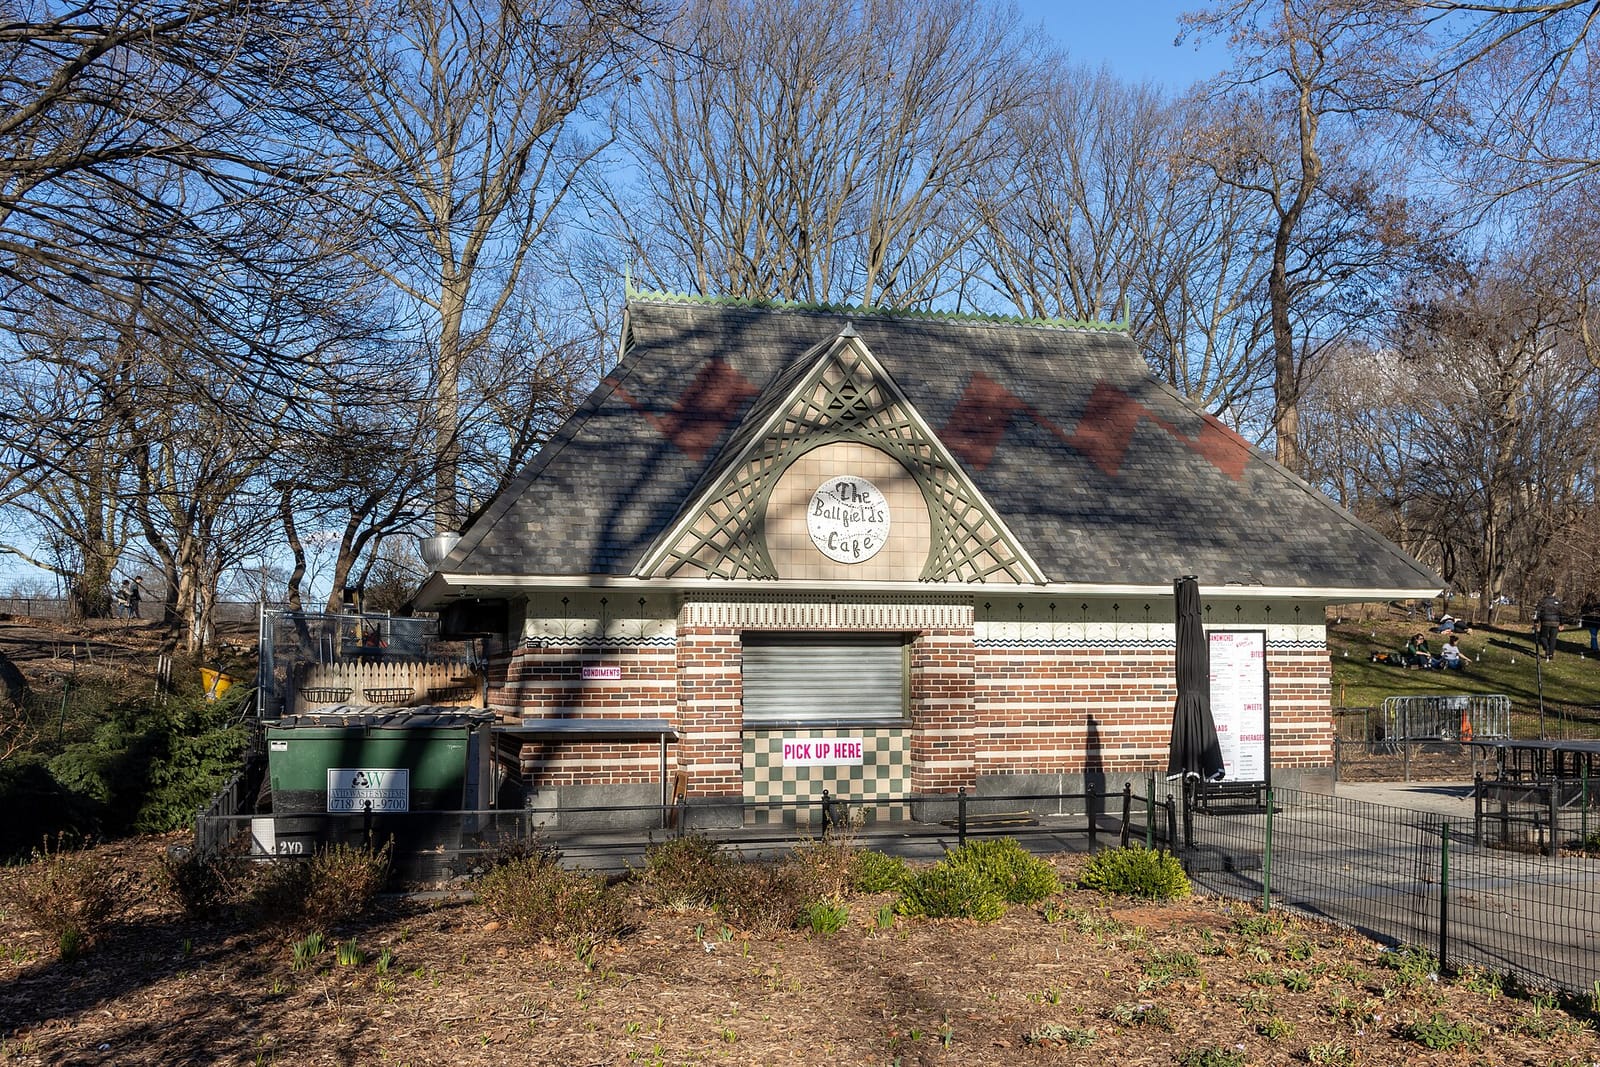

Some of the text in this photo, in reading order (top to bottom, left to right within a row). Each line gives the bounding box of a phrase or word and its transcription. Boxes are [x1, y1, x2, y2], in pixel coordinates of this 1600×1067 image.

[835, 482, 871, 504] The
[812, 497, 884, 527] Ballfields
[827, 529, 874, 558] Café
[583, 669, 620, 677] CONDIMENTS
[784, 743, 862, 760] PICK UP HERE
[350, 789, 373, 798] WASTE
[374, 789, 406, 798] SYSTEMS
[331, 799, 406, 809] (718) 91-9700
[280, 841, 303, 855] 2YD
